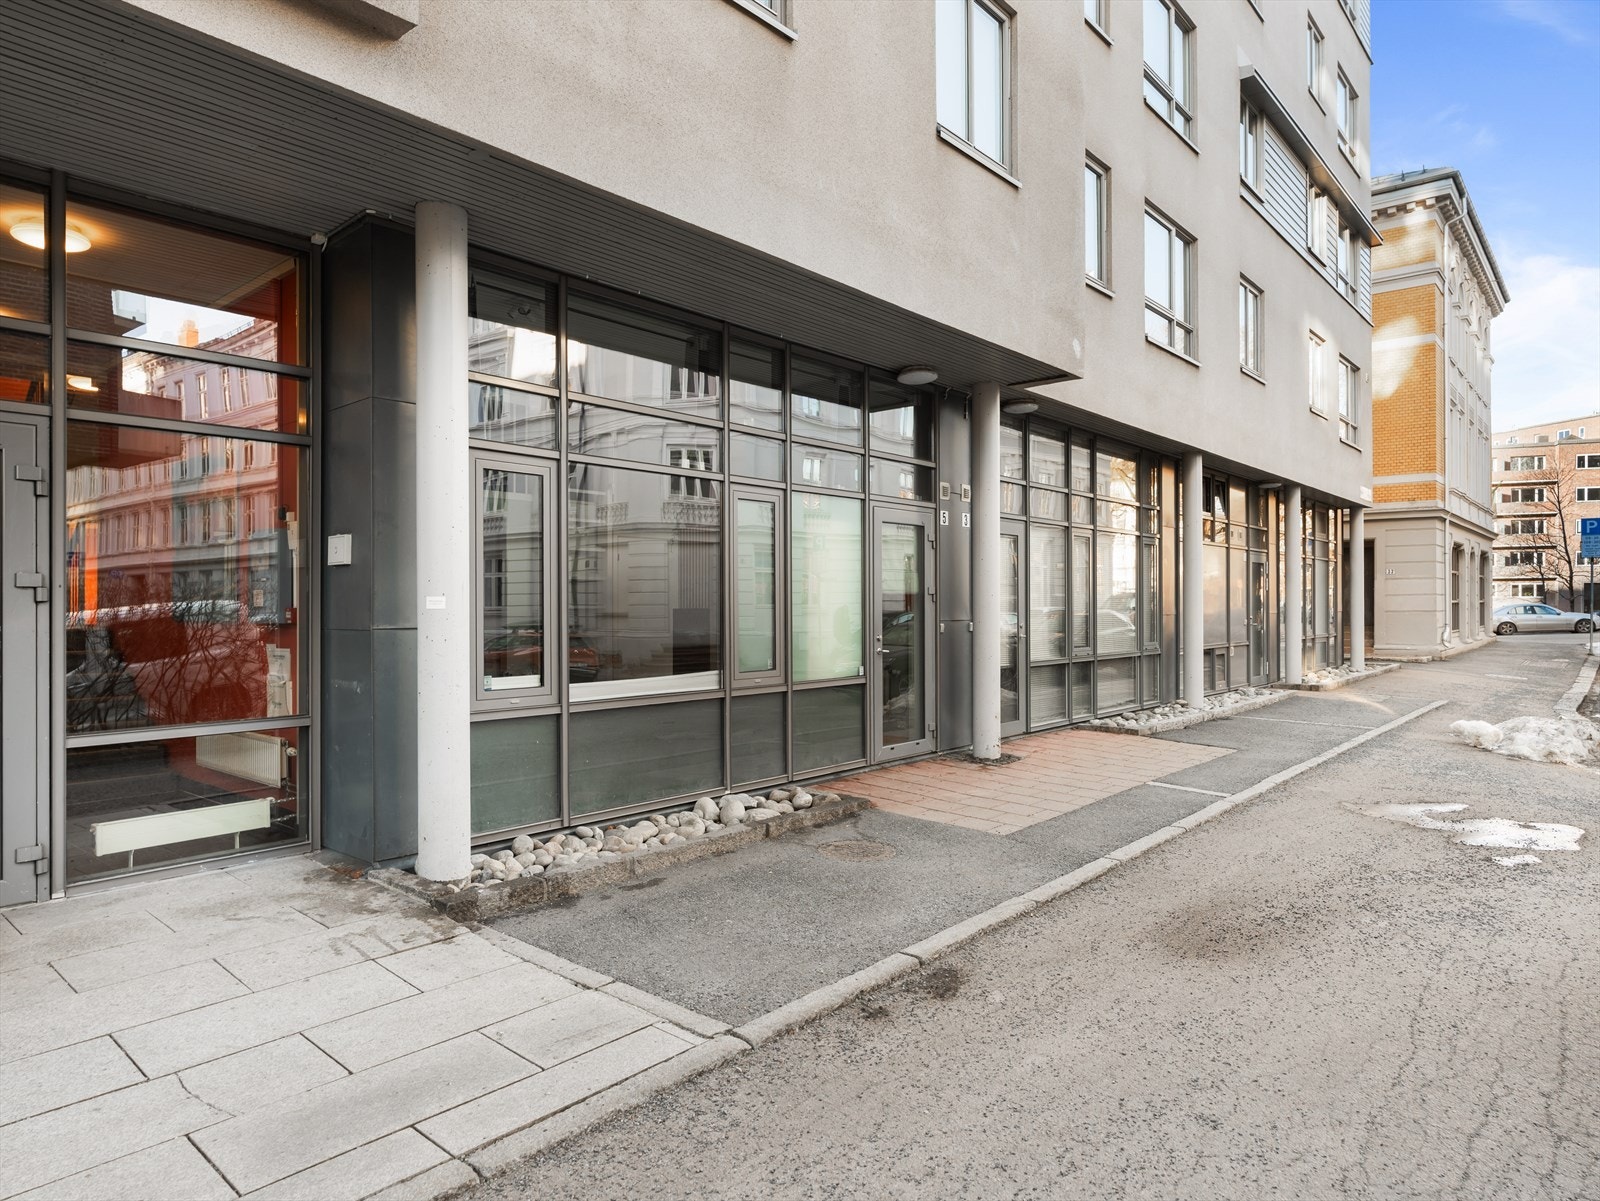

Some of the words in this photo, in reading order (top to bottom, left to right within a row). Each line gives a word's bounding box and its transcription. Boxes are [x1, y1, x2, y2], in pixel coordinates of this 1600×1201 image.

[942, 512, 947, 524] 5
[963, 514, 968, 526] 3
[1587, 520, 1598, 533] P
